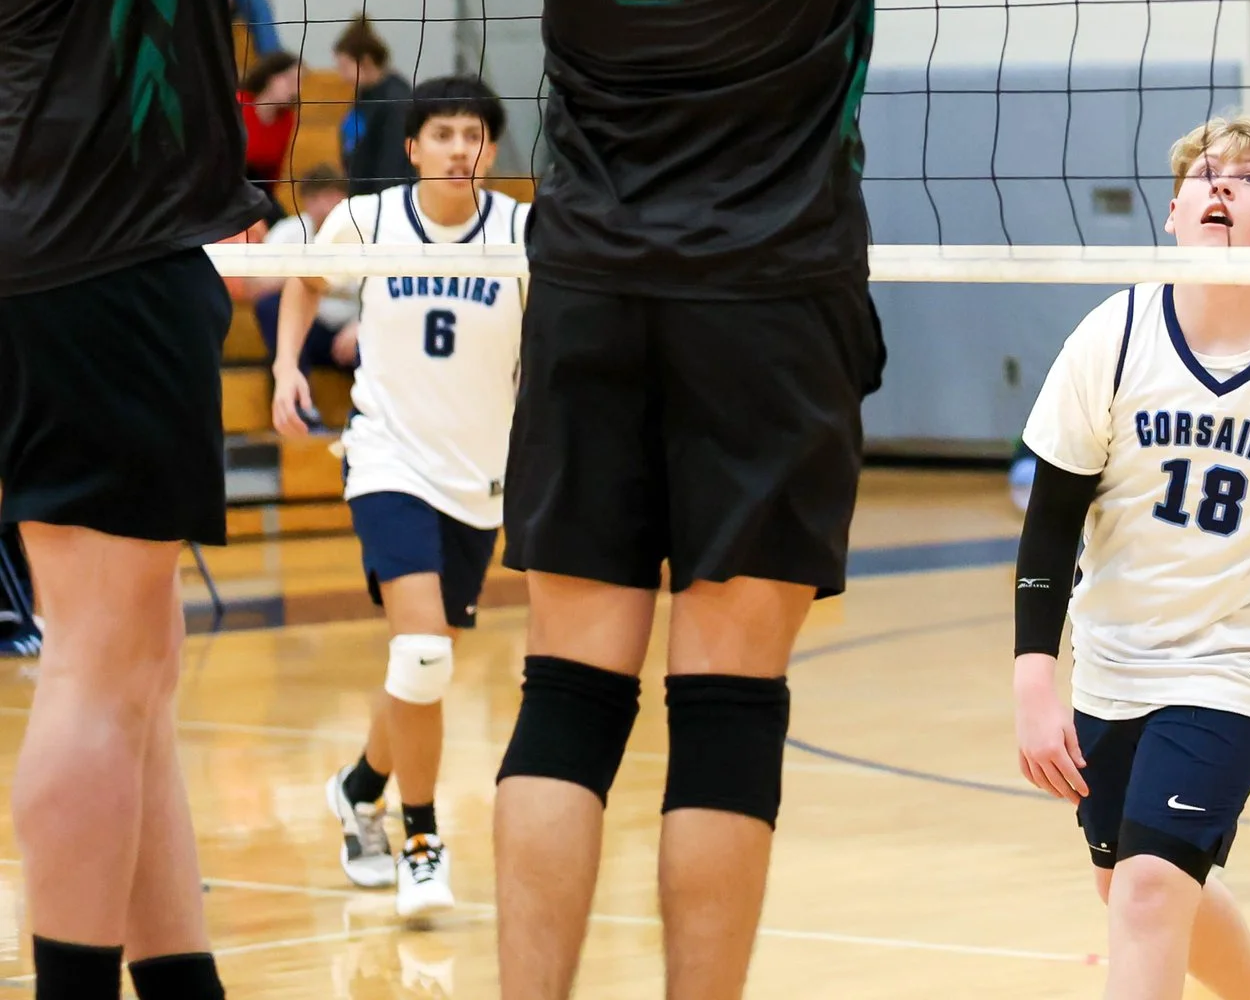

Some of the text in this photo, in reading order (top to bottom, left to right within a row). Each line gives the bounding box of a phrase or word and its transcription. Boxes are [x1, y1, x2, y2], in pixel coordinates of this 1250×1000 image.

[387, 276, 501, 306] CORSAIRS
[424, 309, 458, 358] 6
[1152, 458, 1249, 537] 18
